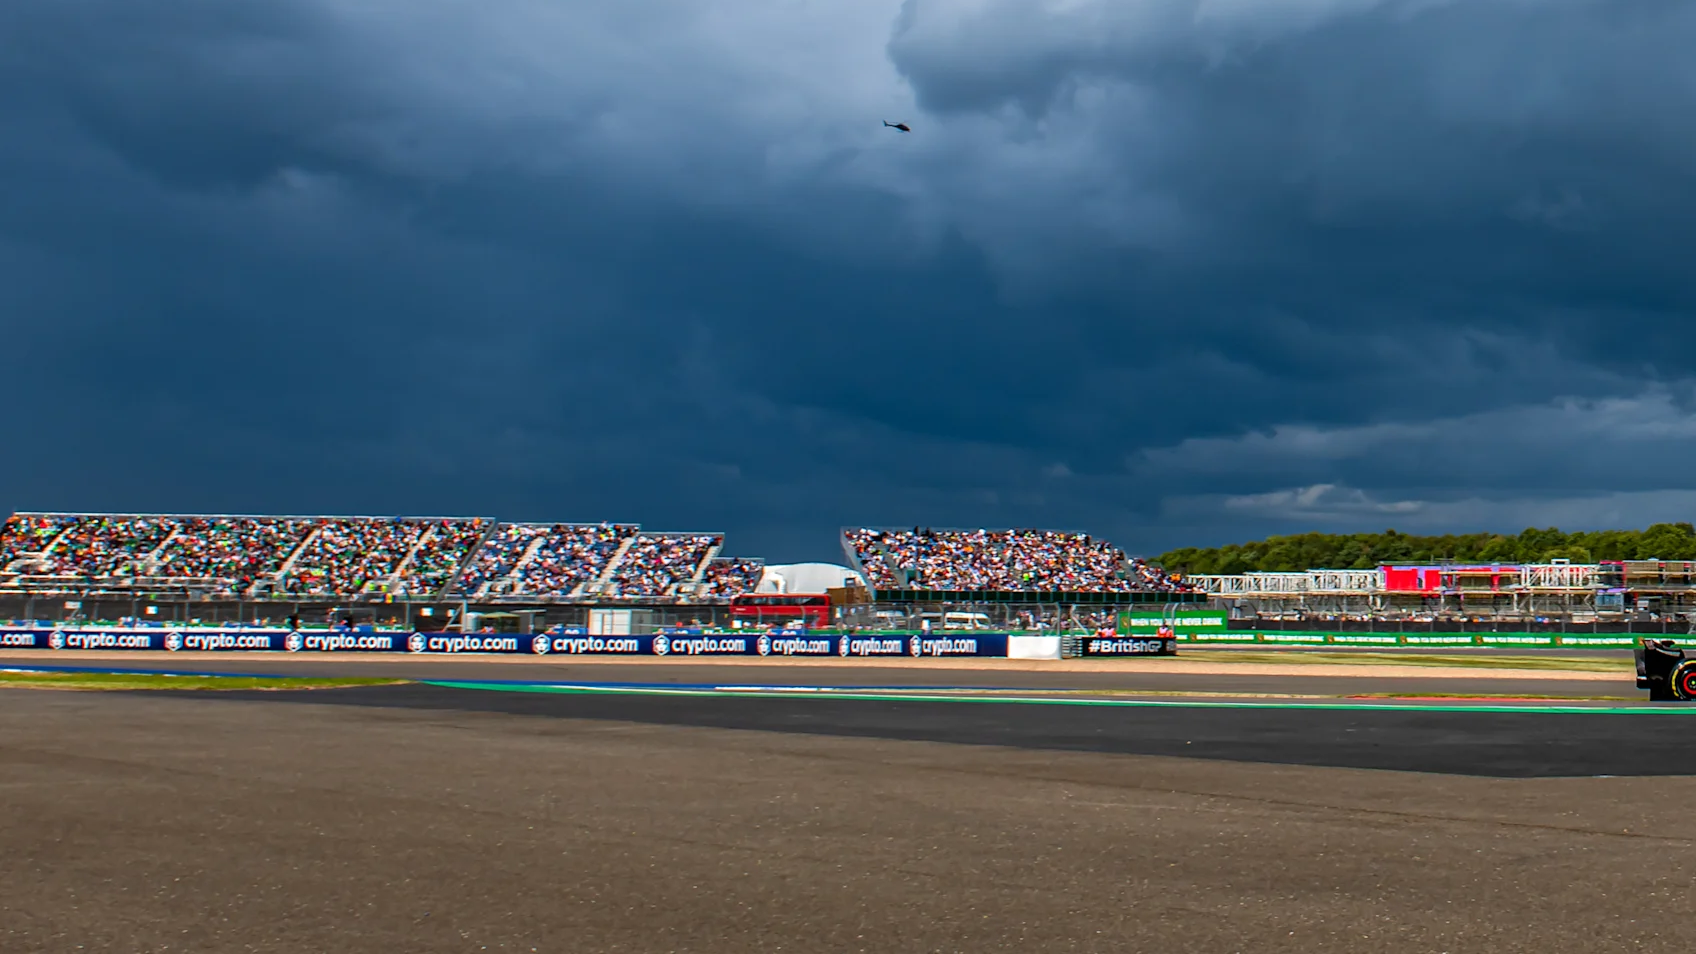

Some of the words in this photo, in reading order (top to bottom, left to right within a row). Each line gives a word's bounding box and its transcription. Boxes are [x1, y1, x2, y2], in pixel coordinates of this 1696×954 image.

[67, 633, 150, 648] crypto.com
[184, 633, 270, 649] crypto.com
[304, 633, 393, 650] crypto.com
[429, 634, 518, 652] crypto.com
[552, 635, 639, 653] crypto.com
[671, 636, 746, 654] crypto.com
[772, 637, 830, 655] crypto.com
[851, 637, 902, 655] crypto.com
[922, 637, 977, 655] crypto.com
